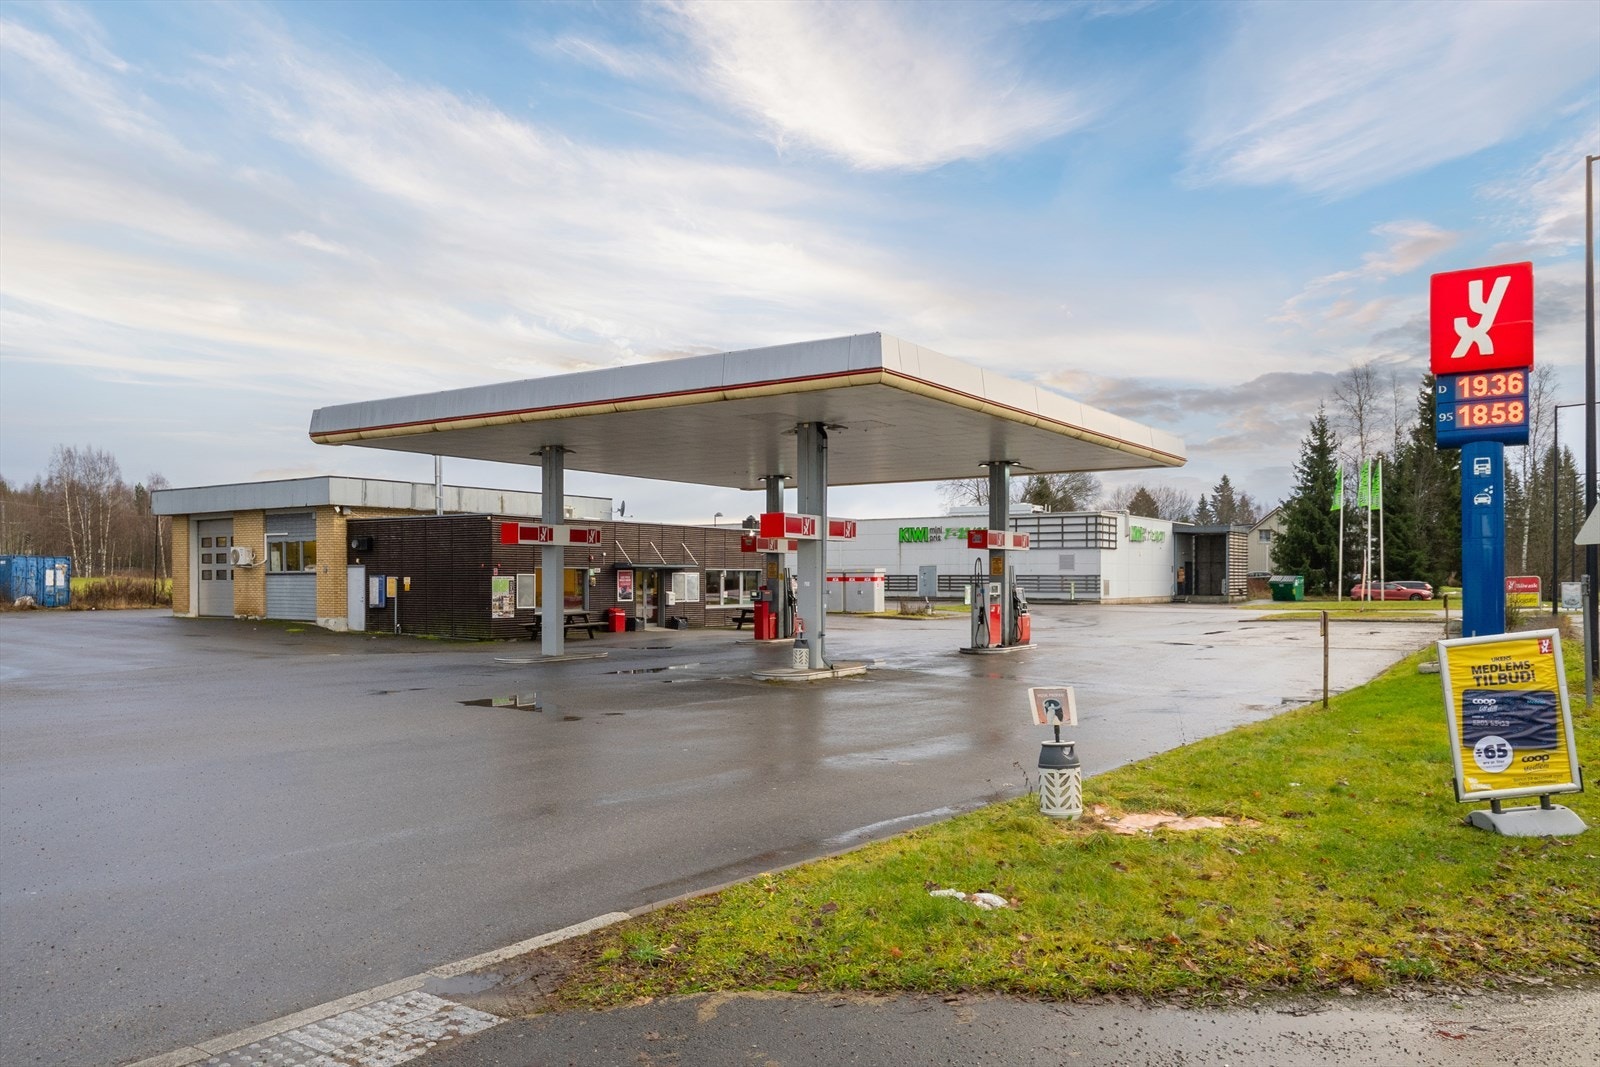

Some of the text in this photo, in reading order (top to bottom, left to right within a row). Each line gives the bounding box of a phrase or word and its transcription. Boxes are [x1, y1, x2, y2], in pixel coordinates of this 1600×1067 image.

[1438, 372, 1524, 398] D 19.36
[1438, 401, 1524, 427] 95 18.58
[899, 527, 928, 542] KIWI
[929, 526, 942, 534] mini
[929, 534, 942, 542] pris
[1471, 661, 1535, 675] MEDLEMS-
[1473, 670, 1536, 687] TILBUD!
[1521, 754, 1550, 763] coop
